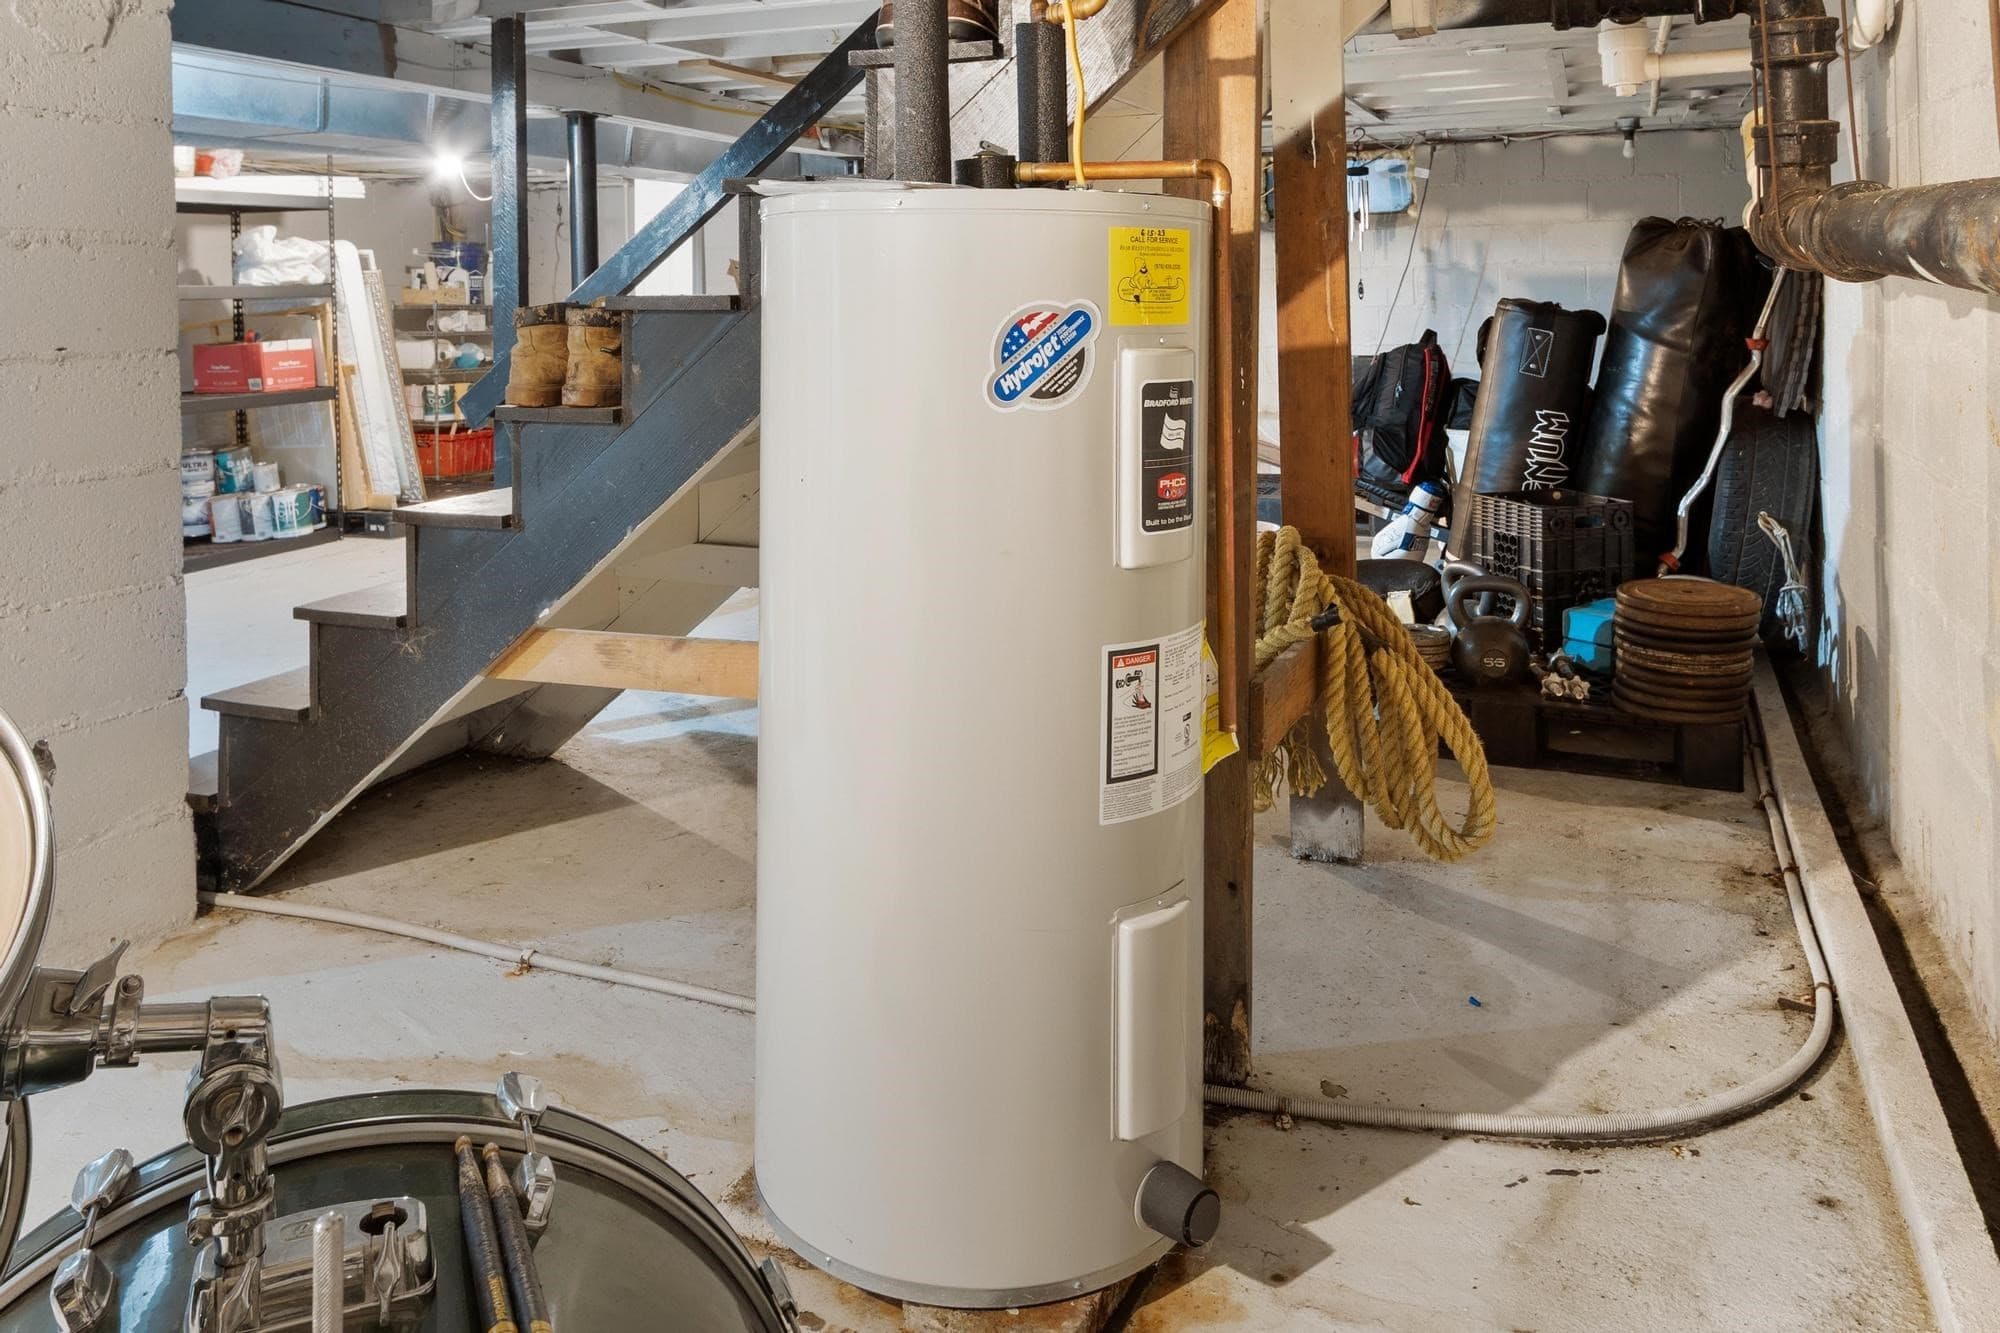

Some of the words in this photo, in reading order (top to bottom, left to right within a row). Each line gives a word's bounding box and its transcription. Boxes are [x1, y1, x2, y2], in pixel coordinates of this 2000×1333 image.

[1000, 335, 1061, 395] Hydrojet
[1144, 399, 1179, 408] BRADFORD
[1522, 410, 1569, 490] NUM
[1160, 477, 1186, 488] PHCC
[1126, 654, 1151, 665] DANGER
[1484, 658, 1505, 667] 55
